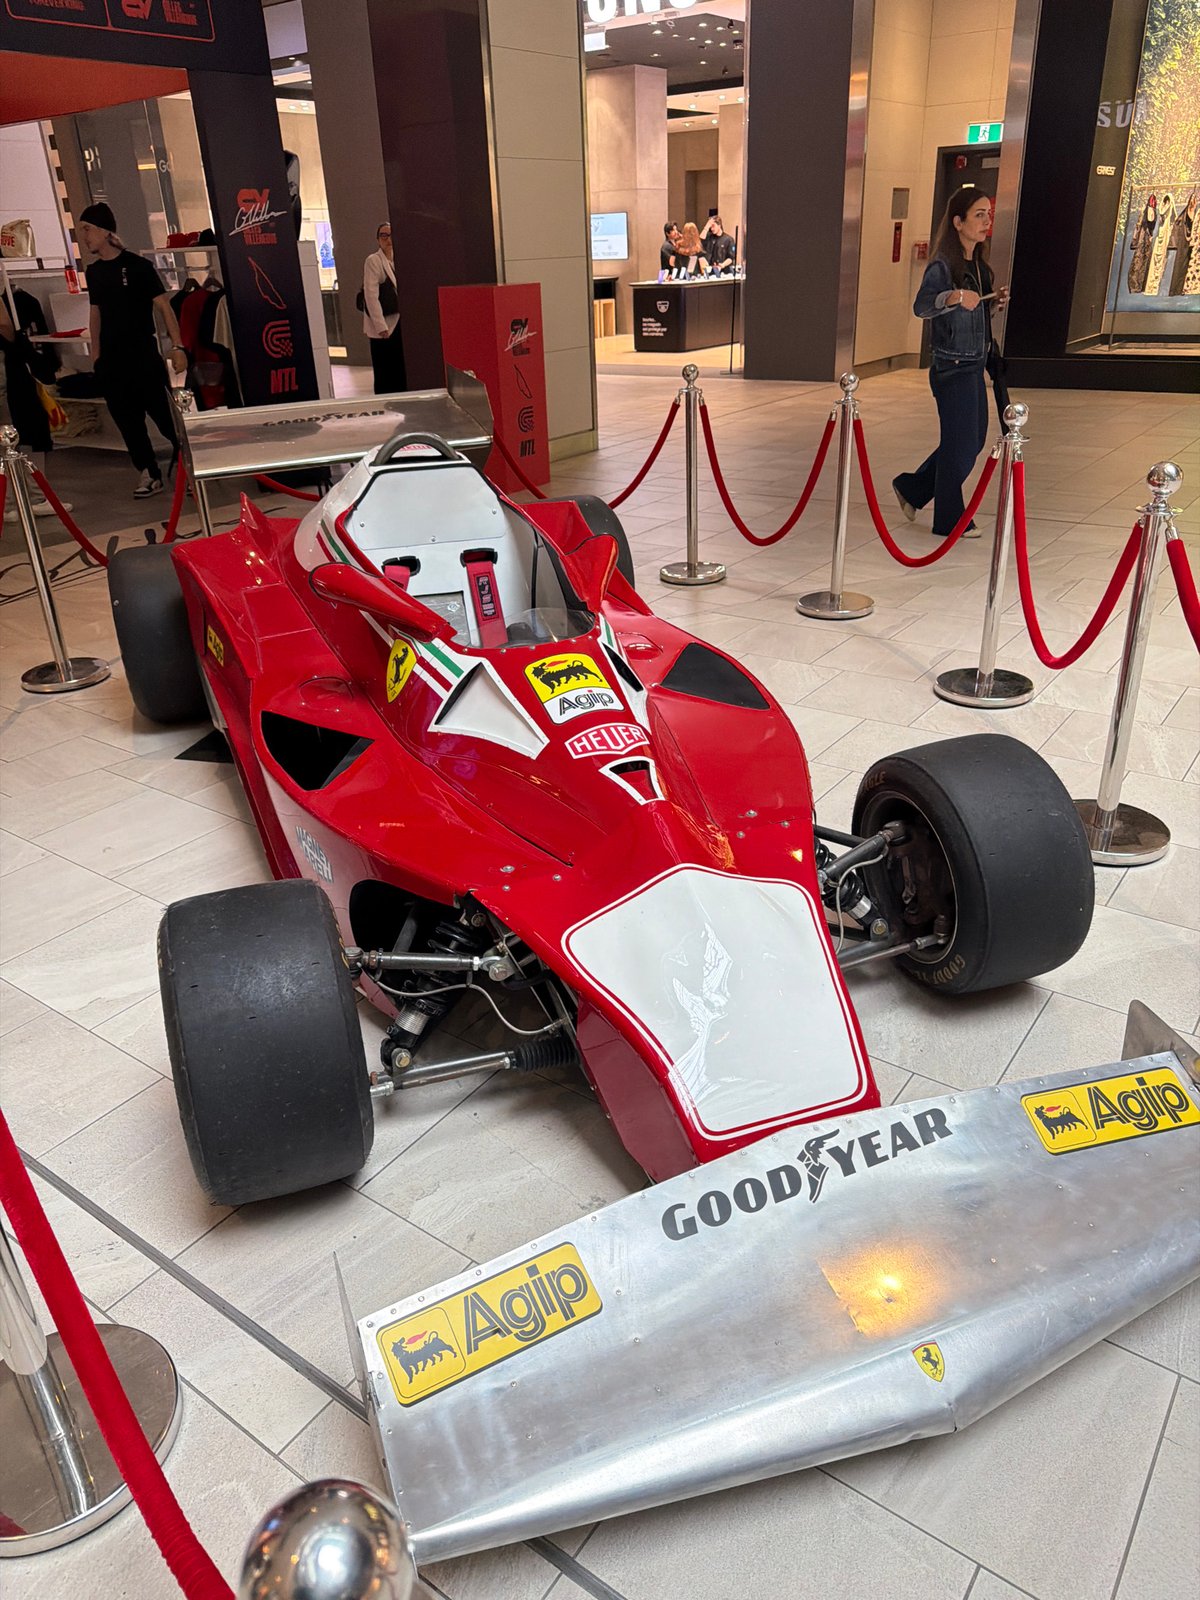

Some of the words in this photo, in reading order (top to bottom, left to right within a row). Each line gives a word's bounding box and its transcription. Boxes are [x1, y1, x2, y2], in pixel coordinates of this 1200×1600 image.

[271, 367, 299, 394] MTL
[262, 410, 385, 426] GOODYEAR
[559, 690, 614, 716] Agip
[573, 726, 645, 753] HEUER
[1087, 1076, 1189, 1131] Agip
[661, 1108, 953, 1241] GOODYEAR
[463, 1263, 588, 1355] Agip
